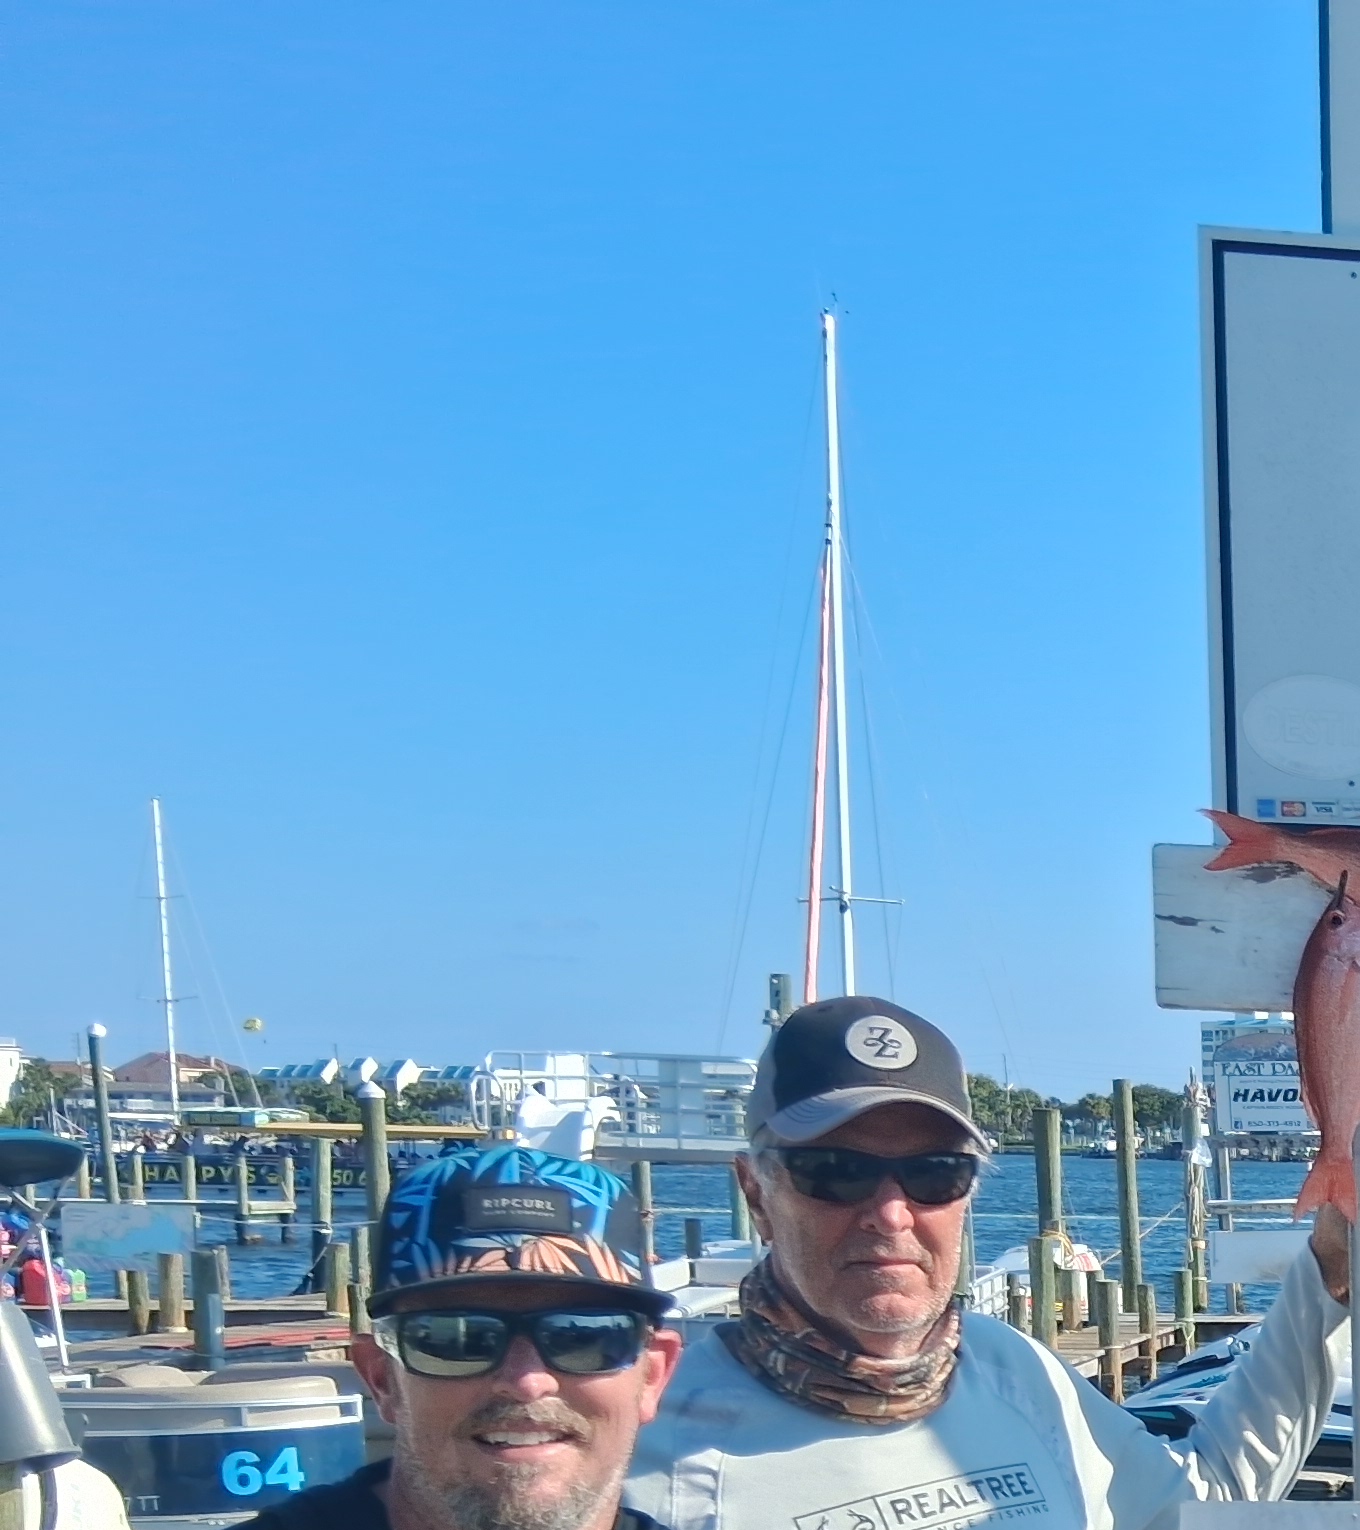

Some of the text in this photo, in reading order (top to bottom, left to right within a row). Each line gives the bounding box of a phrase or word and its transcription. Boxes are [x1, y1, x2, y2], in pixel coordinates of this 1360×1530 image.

[1222, 1062, 1300, 1077] EAST PA
[1232, 1087, 1304, 1103] HAVO
[221, 1446, 306, 1496] 64
[888, 1470, 1036, 1526] REALTREE
[987, 1503, 1050, 1524] FISHING
